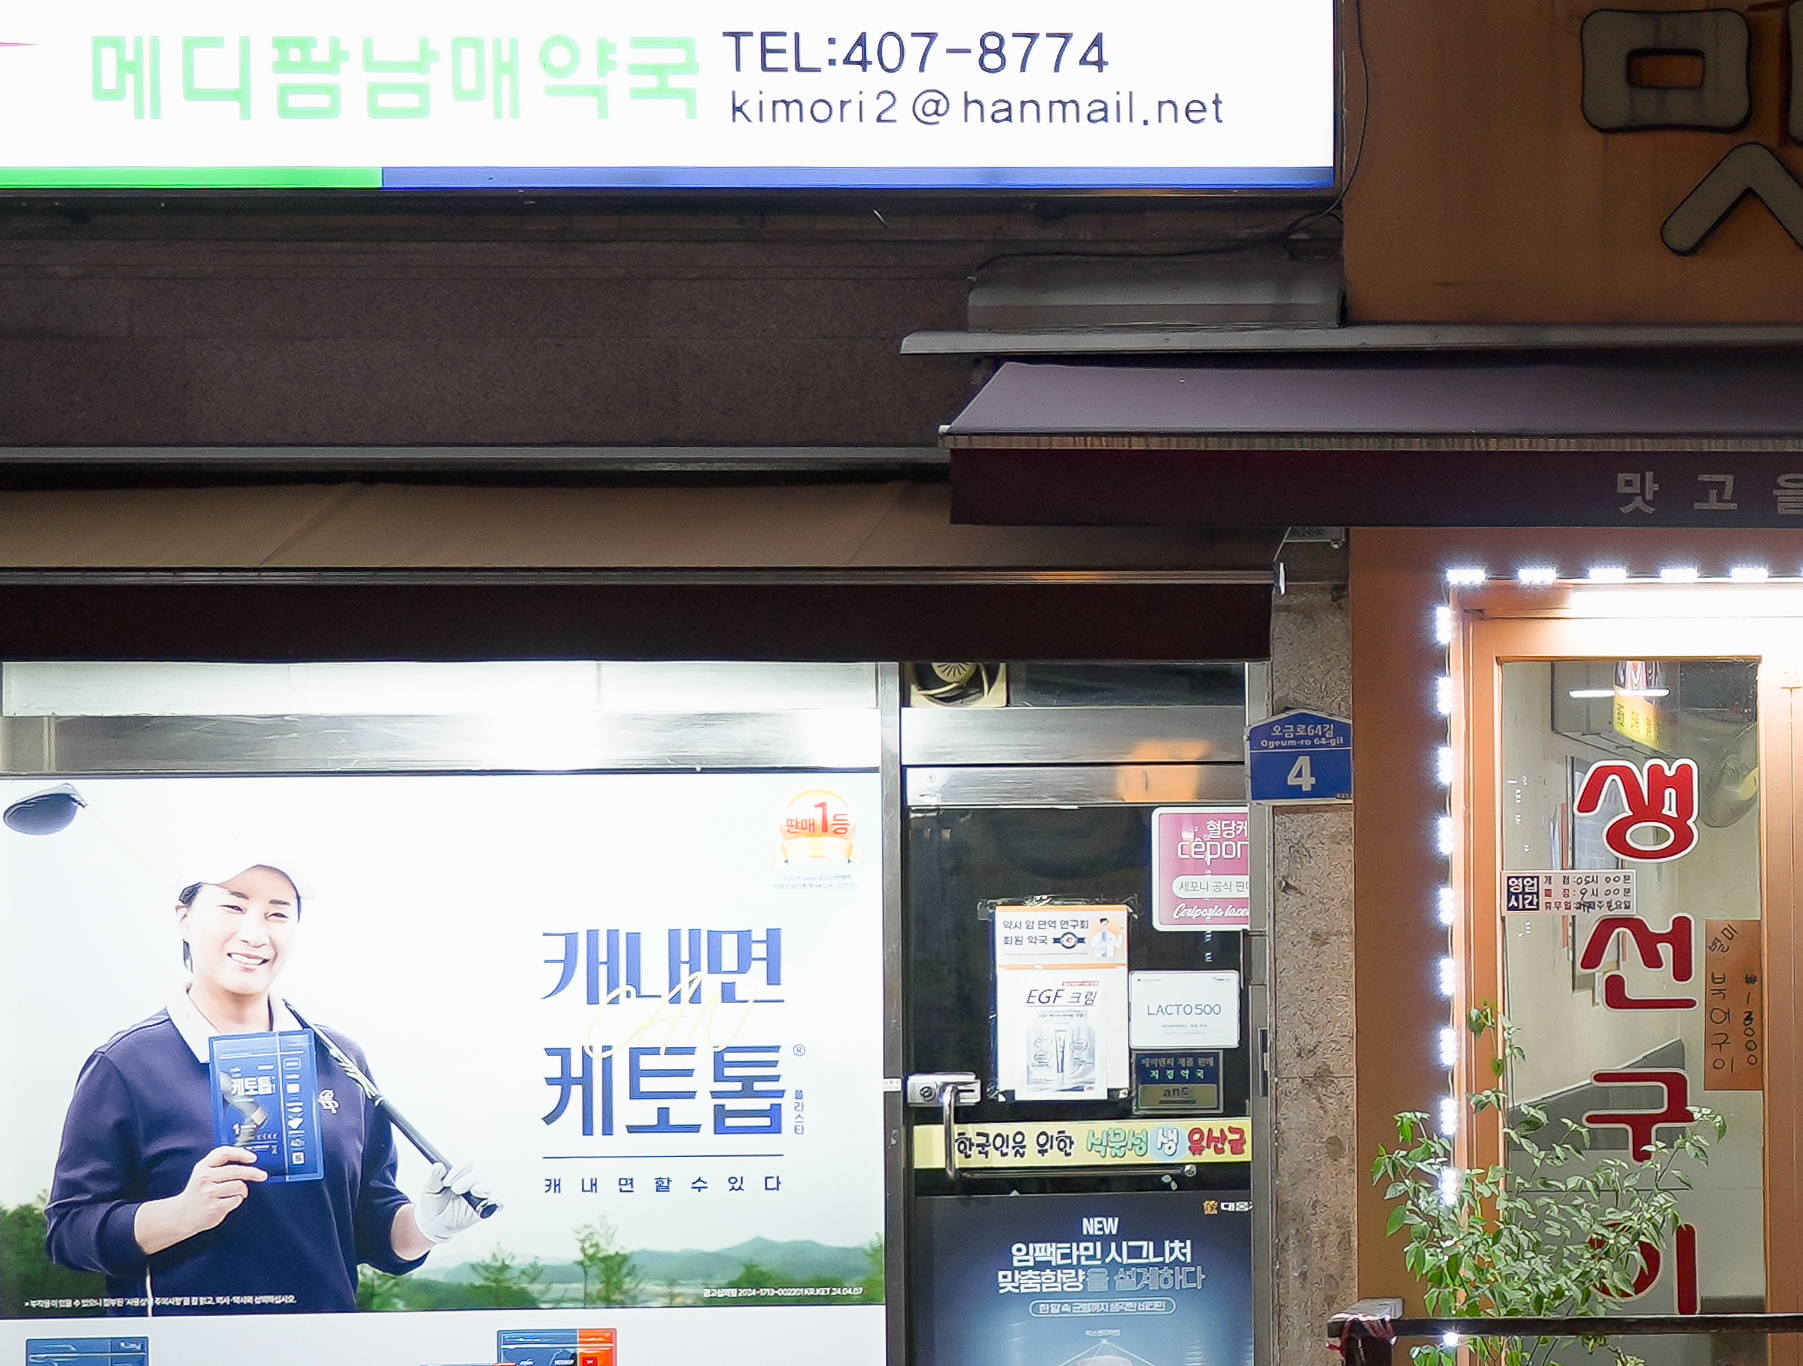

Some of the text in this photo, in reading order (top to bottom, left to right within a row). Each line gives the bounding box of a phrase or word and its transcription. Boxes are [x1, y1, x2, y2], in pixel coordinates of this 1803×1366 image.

[722, 32, 1109, 75] TEL:407-8774
[90, 32, 701, 121] 메디팜남매약국
[1261, 737, 1344, 748] Ogeum-ro 64-gil
[1271, 724, 1333, 738] 오금로64길
[1287, 756, 1316, 791] 4
[1509, 878, 1537, 892] 영업
[1509, 894, 1538, 909] 시간
[541, 928, 784, 1005] 캐내면
[1026, 989, 1097, 1006] EGF 크림
[541, 1045, 786, 1137] 케토톱
[956, 1130, 1027, 1159] 한국인을
[1036, 1130, 1075, 1158] 위한
[1187, 1126, 1246, 1157] 유산균
[1082, 1217, 1119, 1235] NEW
[1011, 1239, 1192, 1267] 임팩타민 시그니처
[998, 1266, 1206, 1294] 맞춤함량을 설계하다
